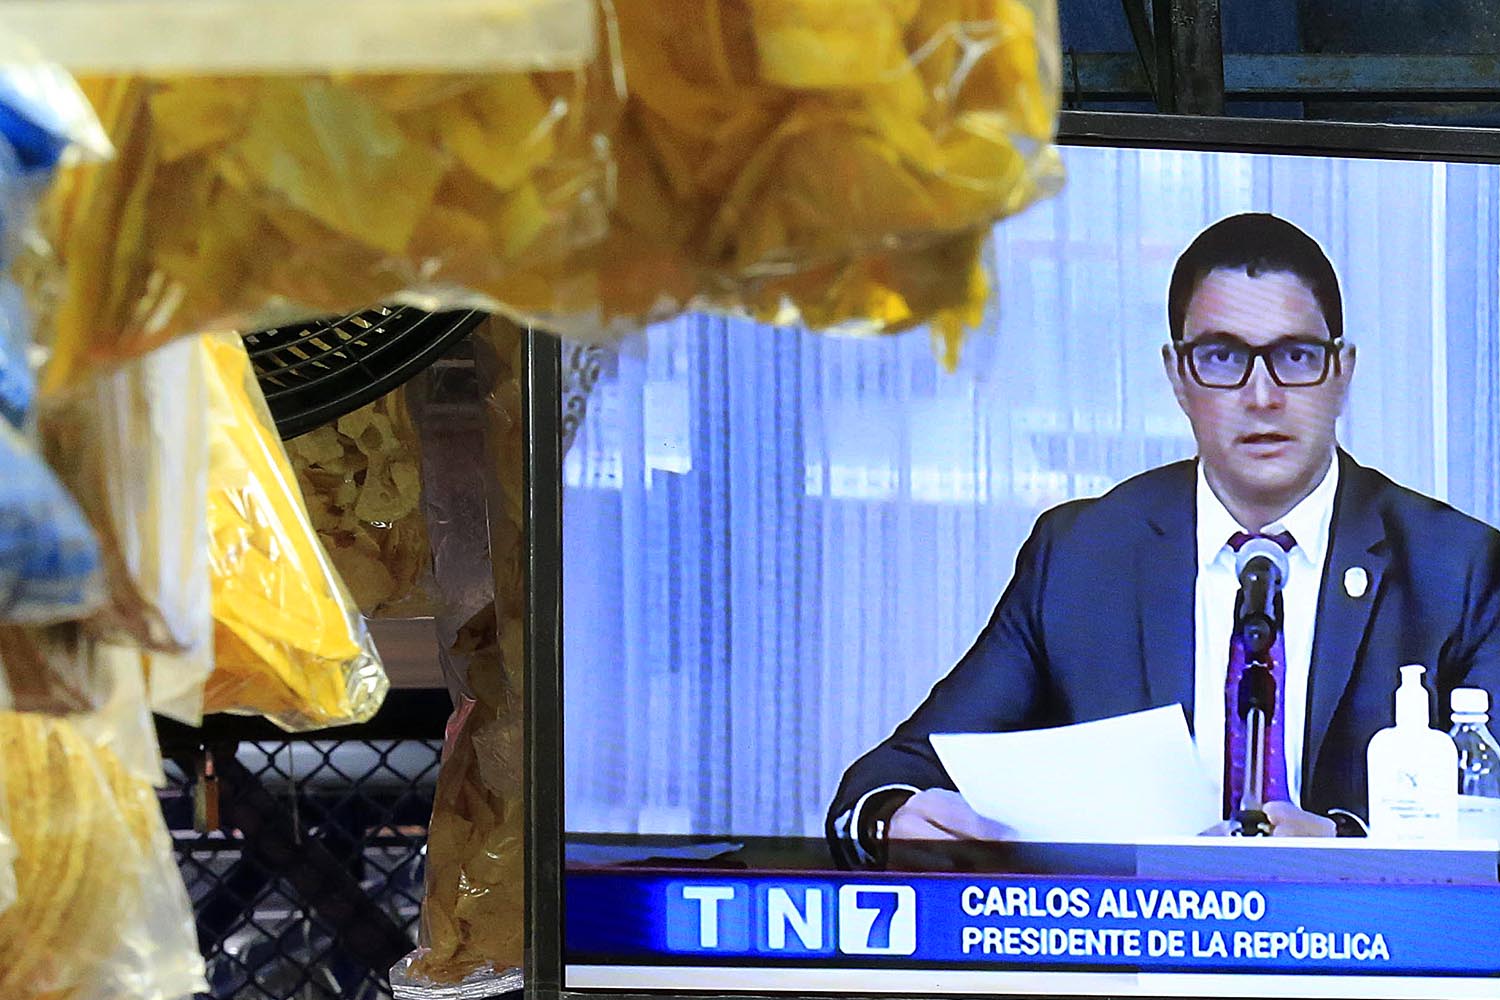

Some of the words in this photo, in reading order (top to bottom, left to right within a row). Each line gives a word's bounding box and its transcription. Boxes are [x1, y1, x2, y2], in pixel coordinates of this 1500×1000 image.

[961, 886, 1091, 918] CARLOS
[1097, 888, 1266, 921] ALVARADO
[961, 926, 1142, 957] PRESIDENTE
[1147, 929, 1185, 958] DE
[1192, 930, 1228, 959] LA
[1233, 926, 1390, 960] REPÚBLICA
